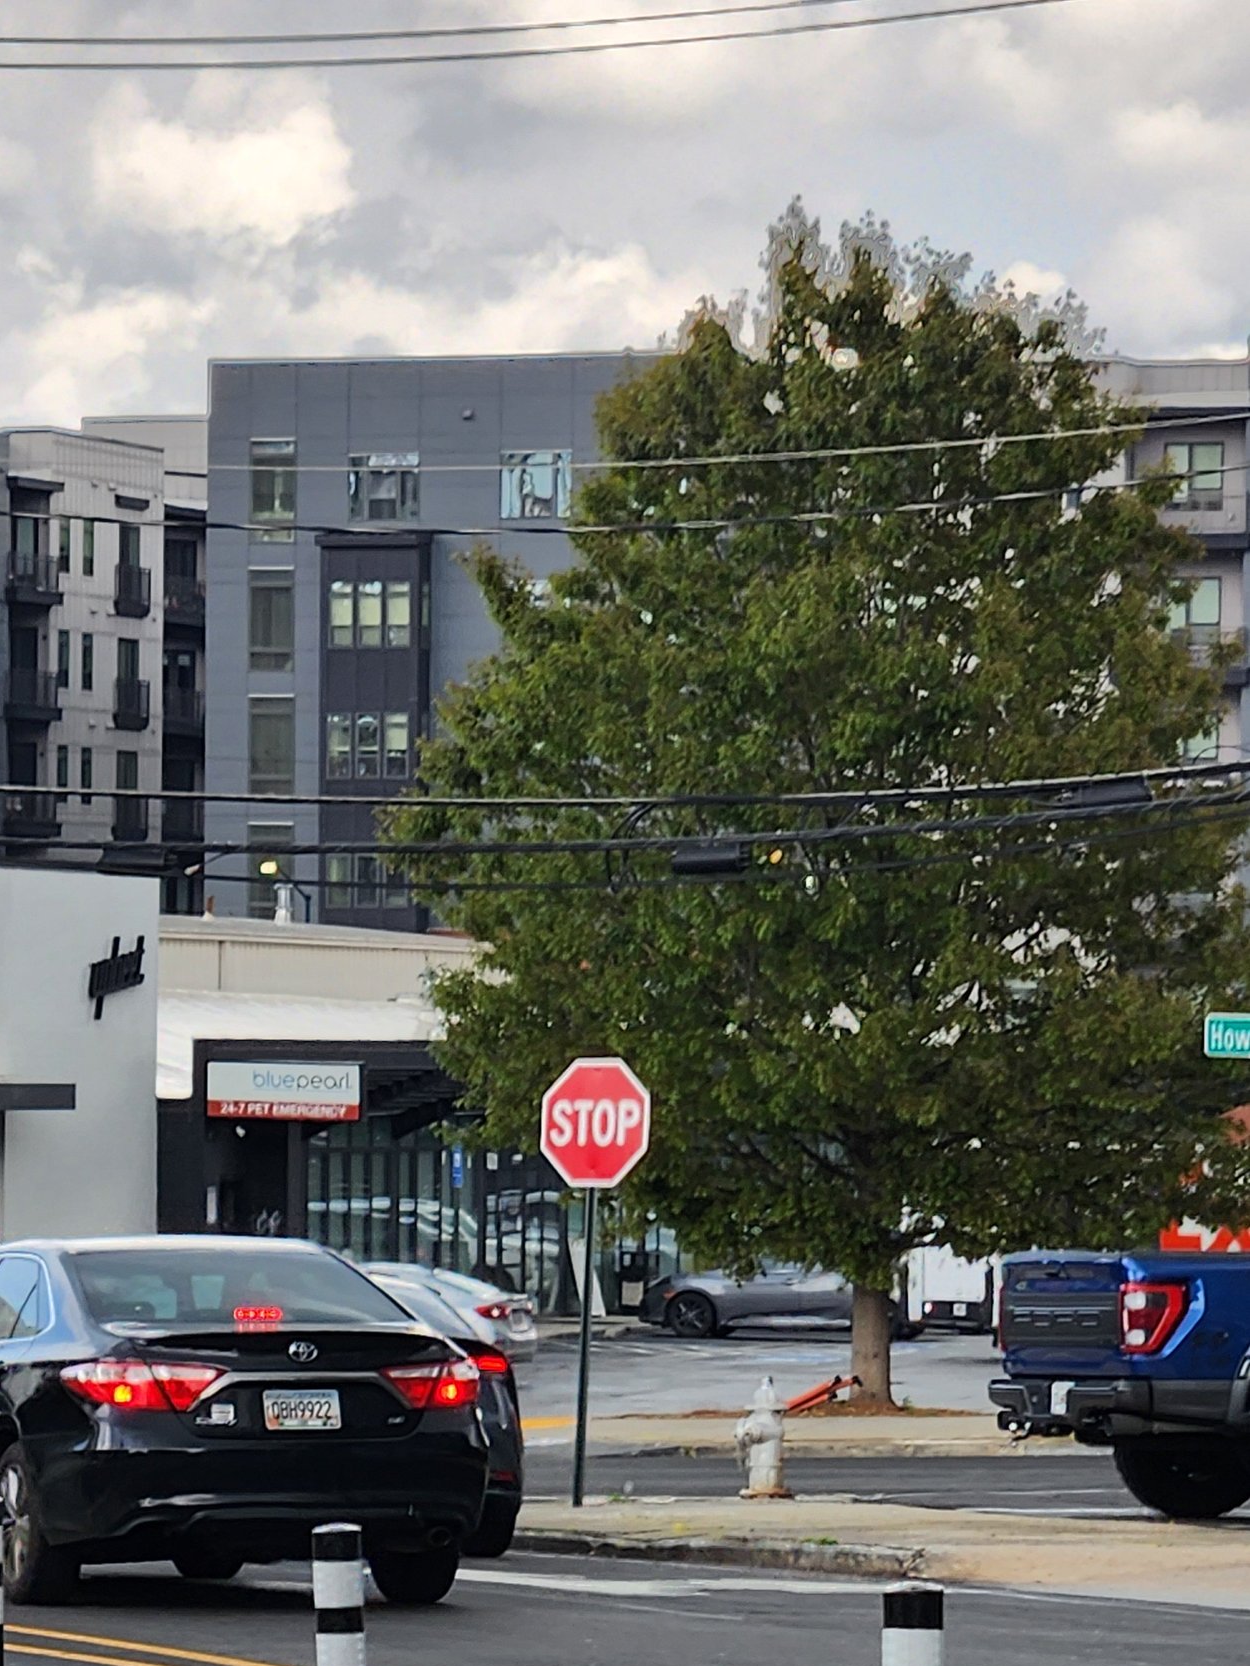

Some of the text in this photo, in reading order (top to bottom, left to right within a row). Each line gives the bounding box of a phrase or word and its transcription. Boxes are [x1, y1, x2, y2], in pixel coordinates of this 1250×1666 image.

[252, 1070, 350, 1092] bluepearl
[220, 1103, 347, 1118] 24-7 PET EMERGENCY
[550, 1098, 641, 1148] STOP
